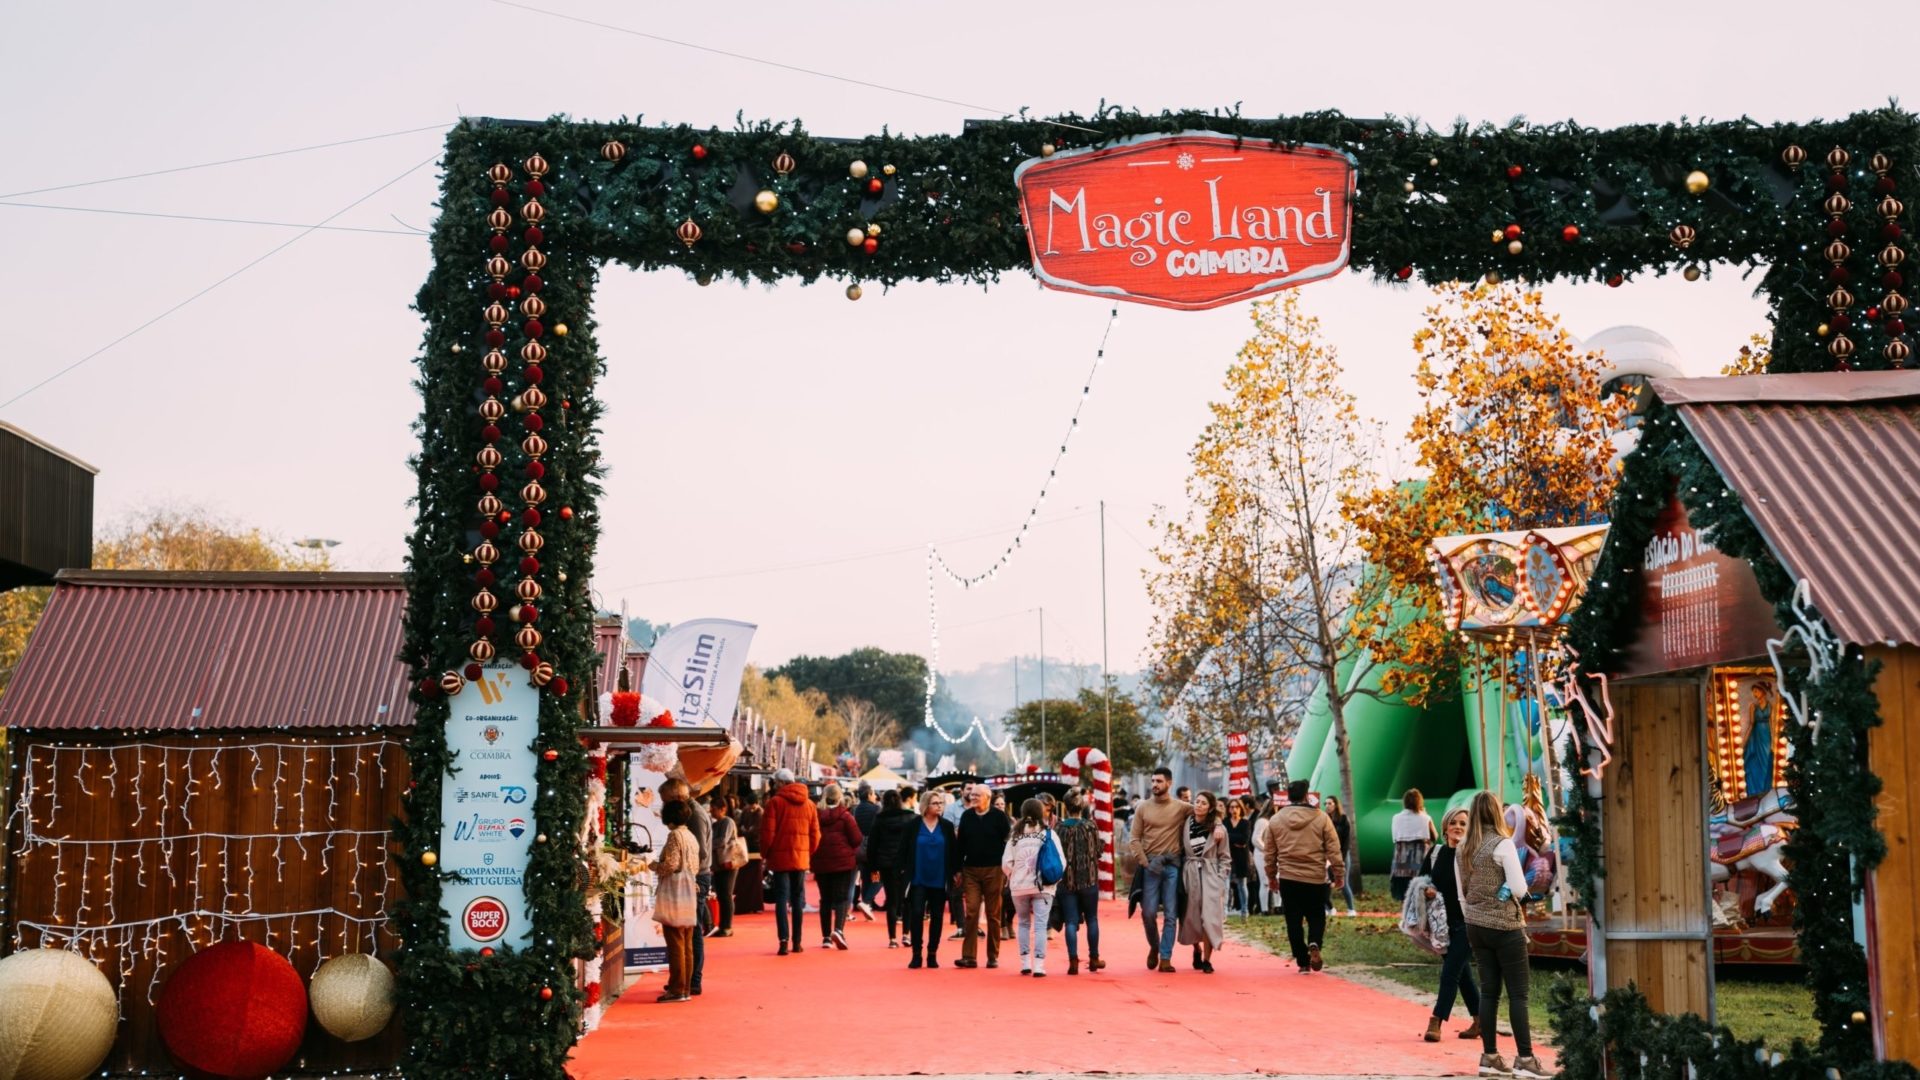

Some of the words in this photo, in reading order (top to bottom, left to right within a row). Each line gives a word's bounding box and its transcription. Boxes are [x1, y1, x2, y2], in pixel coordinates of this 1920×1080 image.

[1043, 186, 1194, 267] Magic
[1204, 175, 1338, 247] Land
[1166, 246, 1290, 278] COIMBRA
[469, 751, 512, 760] COIMBRA
[470, 791, 499, 799] SANFIL
[458, 867, 517, 875] COMPANHIA
[470, 910, 501, 920] SUPER
[471, 919, 500, 928] BOCK
